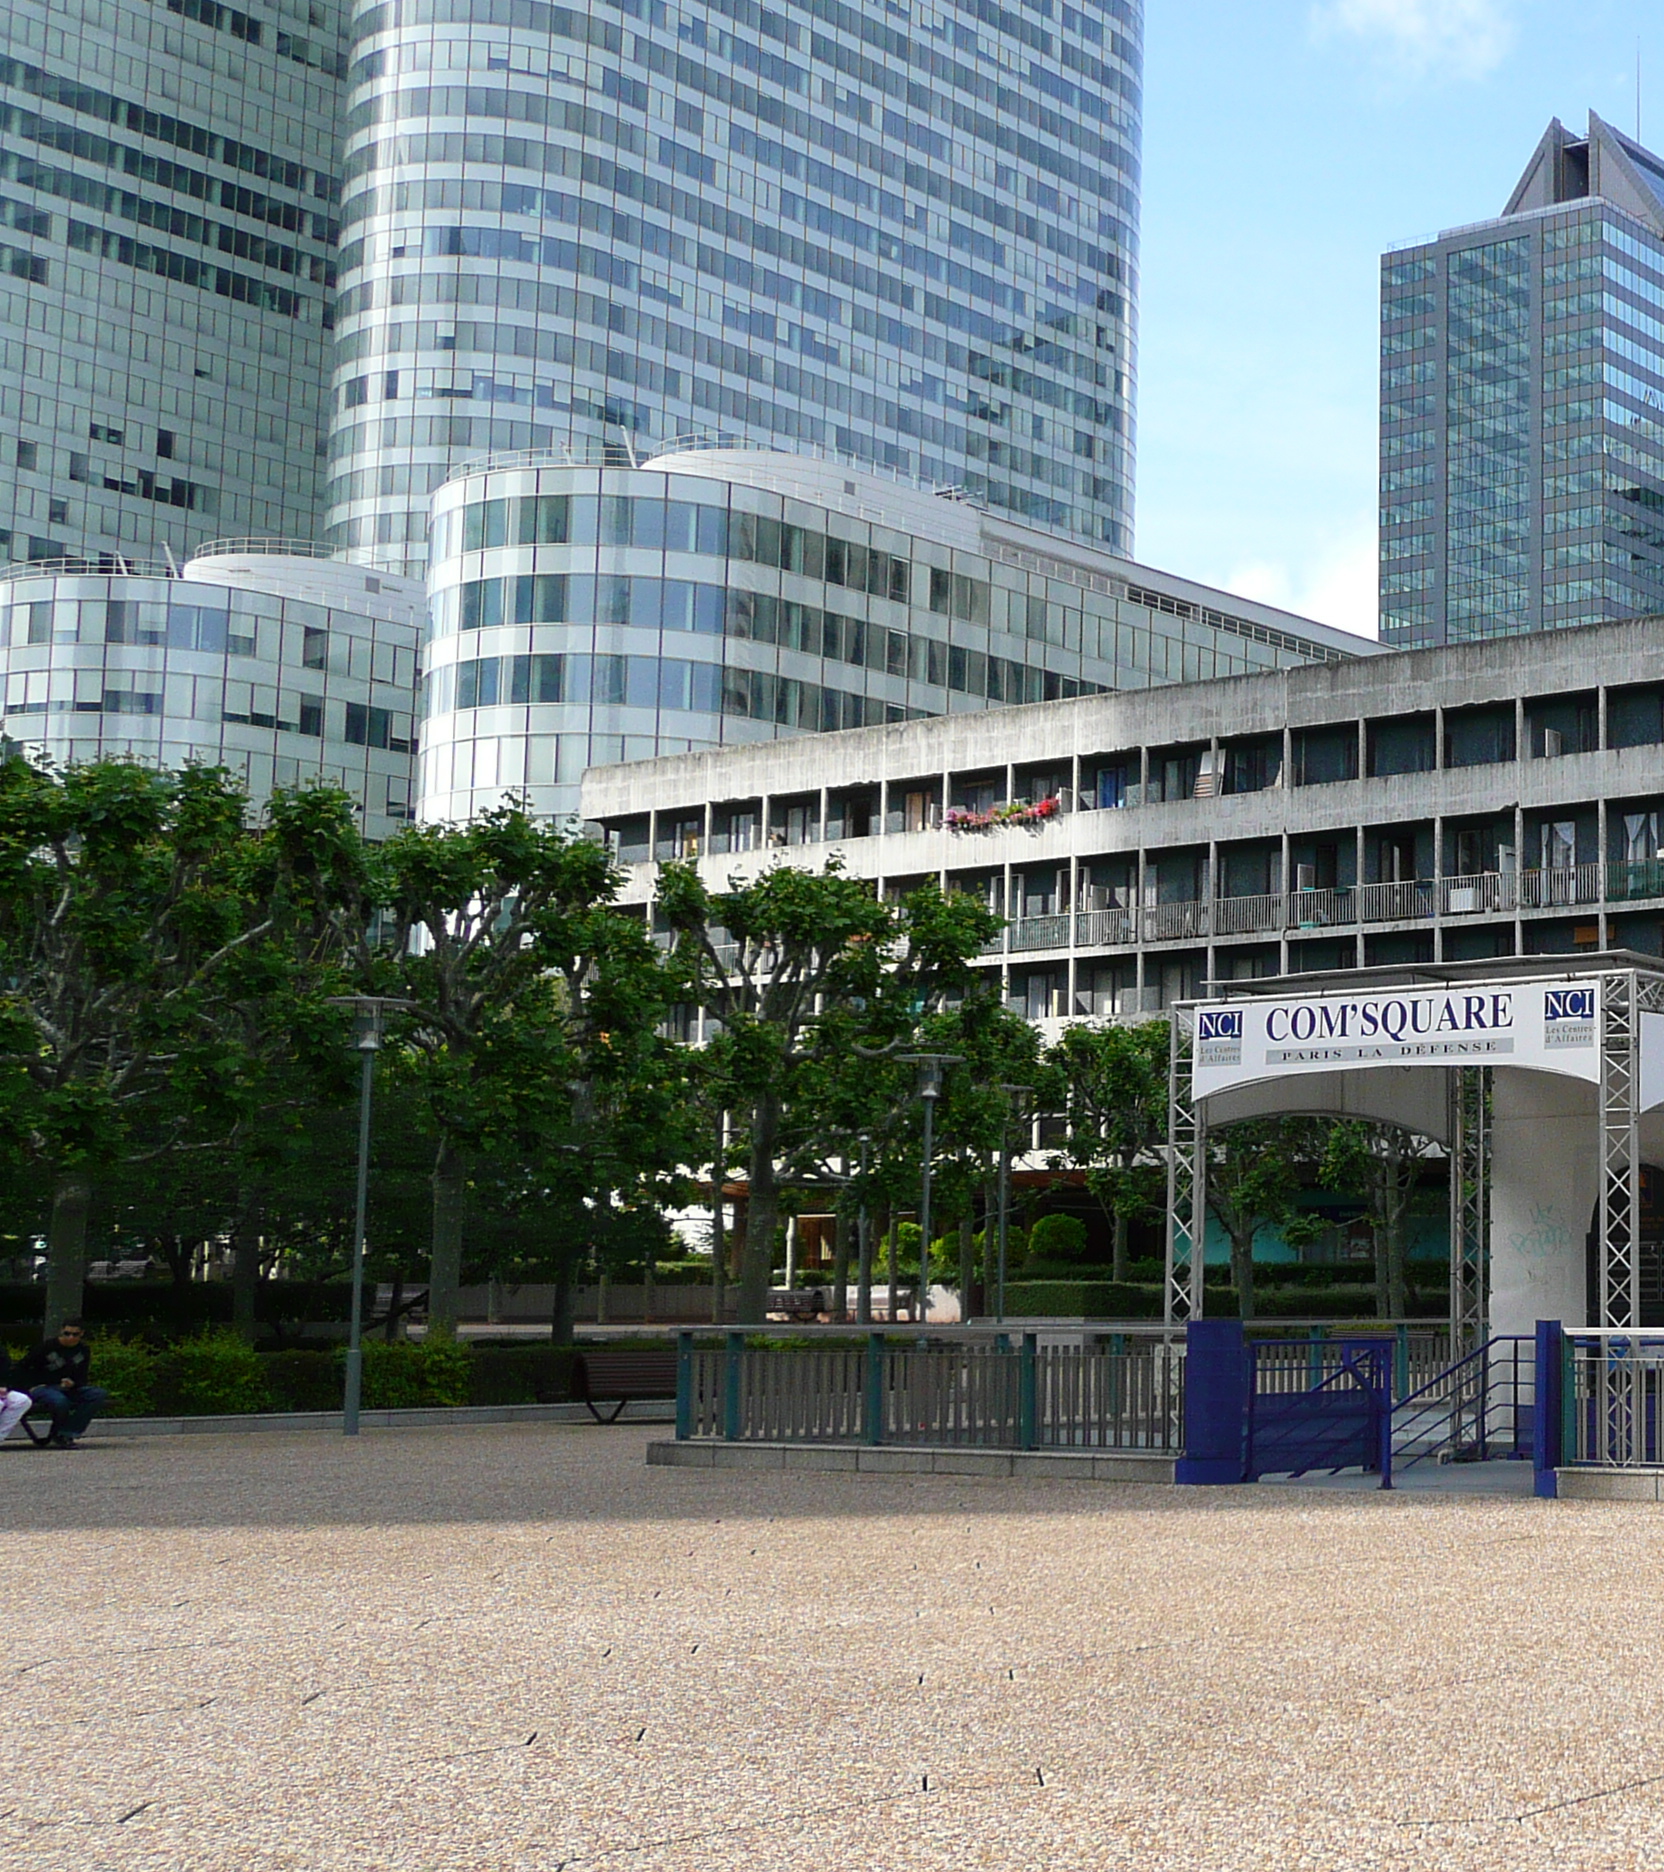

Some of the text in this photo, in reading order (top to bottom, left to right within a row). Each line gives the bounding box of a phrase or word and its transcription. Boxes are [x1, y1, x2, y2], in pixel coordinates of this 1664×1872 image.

[1546, 990, 1592, 1018] NCI
[1200, 1012, 1241, 1037] NCI
[1266, 993, 1514, 1042] COM'SQUARE
[1545, 1034, 1592, 1043] d'Affaires
[1546, 1025, 1560, 1034] Les
[1282, 1041, 1497, 1061] PARIS LA DÉFENSE
